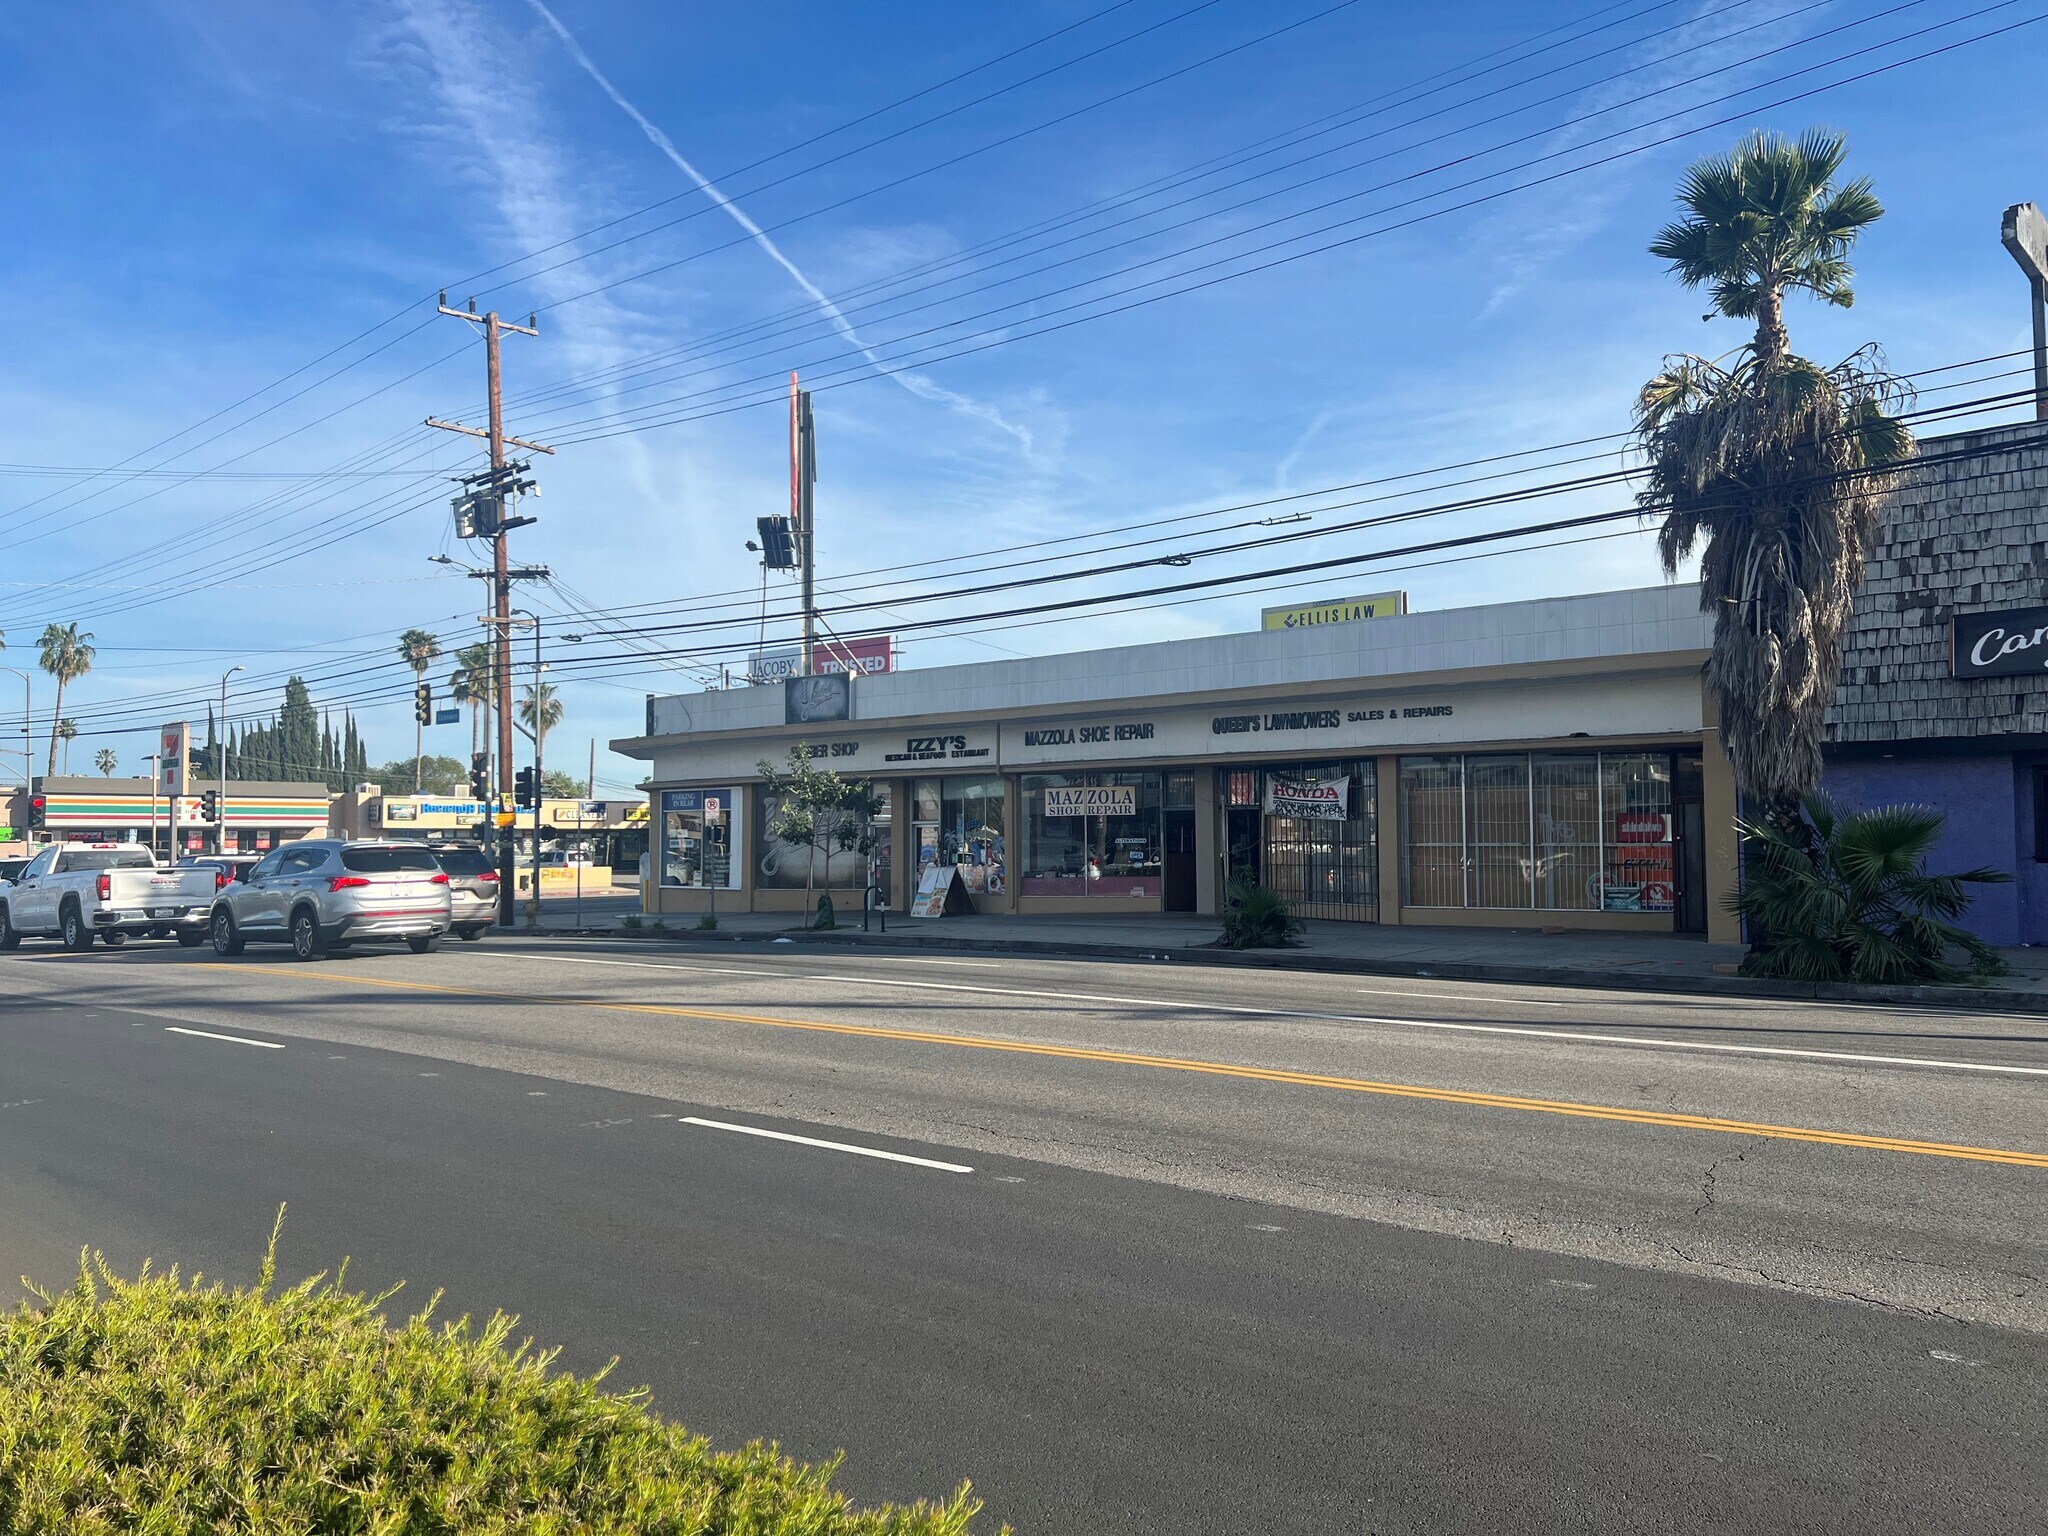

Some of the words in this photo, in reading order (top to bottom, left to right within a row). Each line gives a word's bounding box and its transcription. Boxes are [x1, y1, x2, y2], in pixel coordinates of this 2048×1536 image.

[1300, 609, 1338, 626] ELLIS
[1345, 605, 1375, 621] LAW
[753, 659, 795, 676] JACOBY
[821, 656, 886, 674] TRUSTED
[1212, 715, 1260, 734] QUEEN'S
[1264, 710, 1340, 731] LAWNMOWERS
[1347, 710, 1384, 722] SALES
[1390, 709, 1397, 719] &
[1403, 705, 1453, 718] REPAIRS
[1025, 729, 1075, 746] MAZZOLA
[1079, 726, 1110, 743] SHOE
[1114, 723, 1154, 740] REPAIR
[831, 742, 859, 757] SHOP
[907, 735, 966, 752] IZZY'S
[1047, 789, 1133, 805] MAZZOLA
[1273, 784, 1339, 799] HONDA
[1049, 806, 1081, 815] SHOE
[1088, 805, 1132, 814] REPAIR
